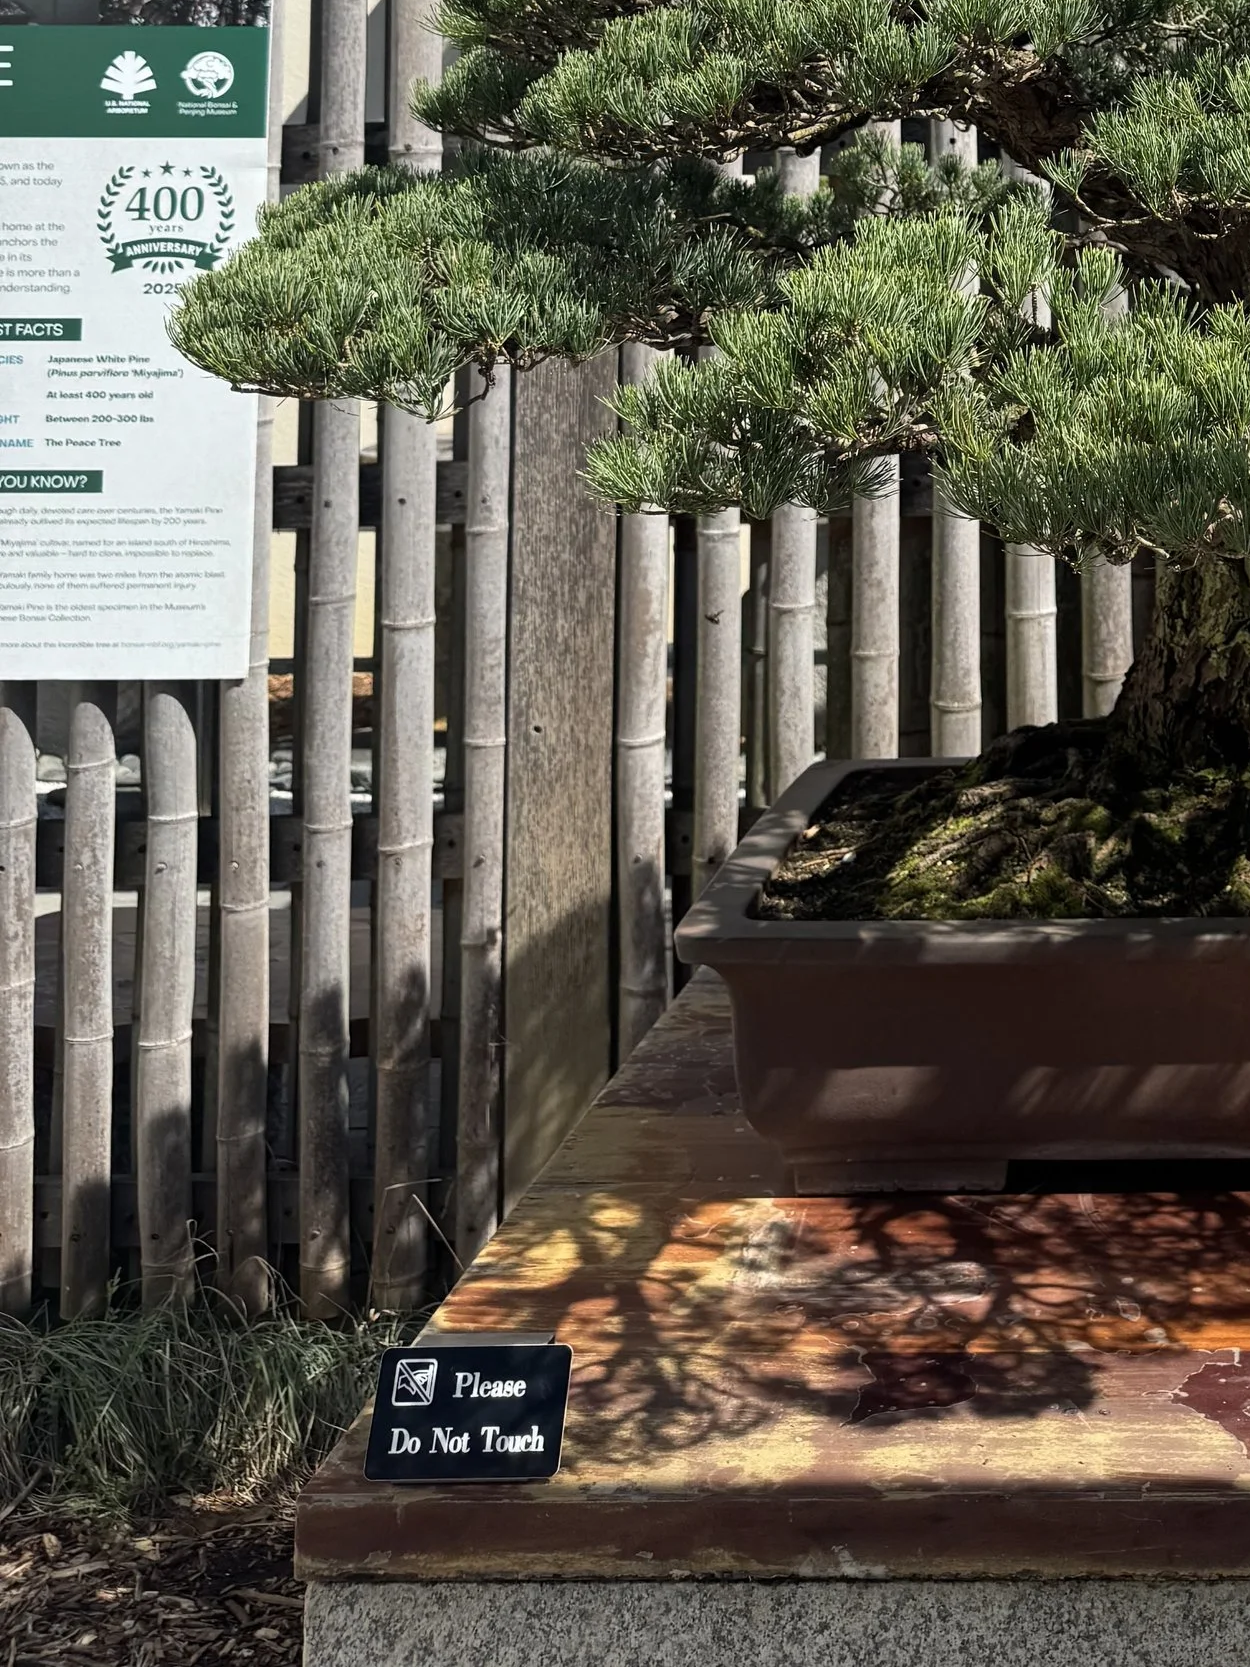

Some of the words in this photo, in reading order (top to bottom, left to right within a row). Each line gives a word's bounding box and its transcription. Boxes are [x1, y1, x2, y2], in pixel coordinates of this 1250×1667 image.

[177, 101, 207, 109] National
[208, 101, 231, 109] Bonsai
[232, 101, 238, 109] &
[22, 162, 35, 171] as
[37, 160, 55, 171] the
[11, 177, 30, 186] and
[33, 177, 63, 188] today
[125, 186, 205, 221] 400
[2, 222, 33, 232] home
[35, 222, 45, 232] at
[48, 222, 65, 232] the
[149, 224, 184, 235] years
[41, 238, 58, 247] the
[126, 241, 204, 256] ANNIVERSARY
[7, 253, 17, 262] in
[19, 253, 32, 262] its
[6, 268, 15, 277] is
[17, 269, 45, 277] more
[48, 268, 71, 277] than
[73, 269, 80, 277] a
[15, 323, 64, 336] FACTS
[47, 355, 94, 366] Japanese
[96, 355, 126, 364] White
[128, 355, 150, 364] Pine
[47, 369, 78, 378] (Pinus
[46, 390, 57, 399] At
[59, 390, 83, 399] least
[85, 391, 106, 400] 400
[108, 392, 136, 401] years
[138, 390, 154, 399] old
[45, 414, 90, 423] Between
[139, 414, 154, 423] lbs
[0, 438, 34, 447] NAME
[45, 438, 63, 447] The
[65, 438, 97, 447] Peace
[99, 438, 121, 447] Tree
[30, 475, 88, 488] KNOW?
[452, 1372, 527, 1398] Please
[387, 1427, 422, 1455] Do
[429, 1427, 471, 1454] Not
[480, 1425, 545, 1453] Touch
